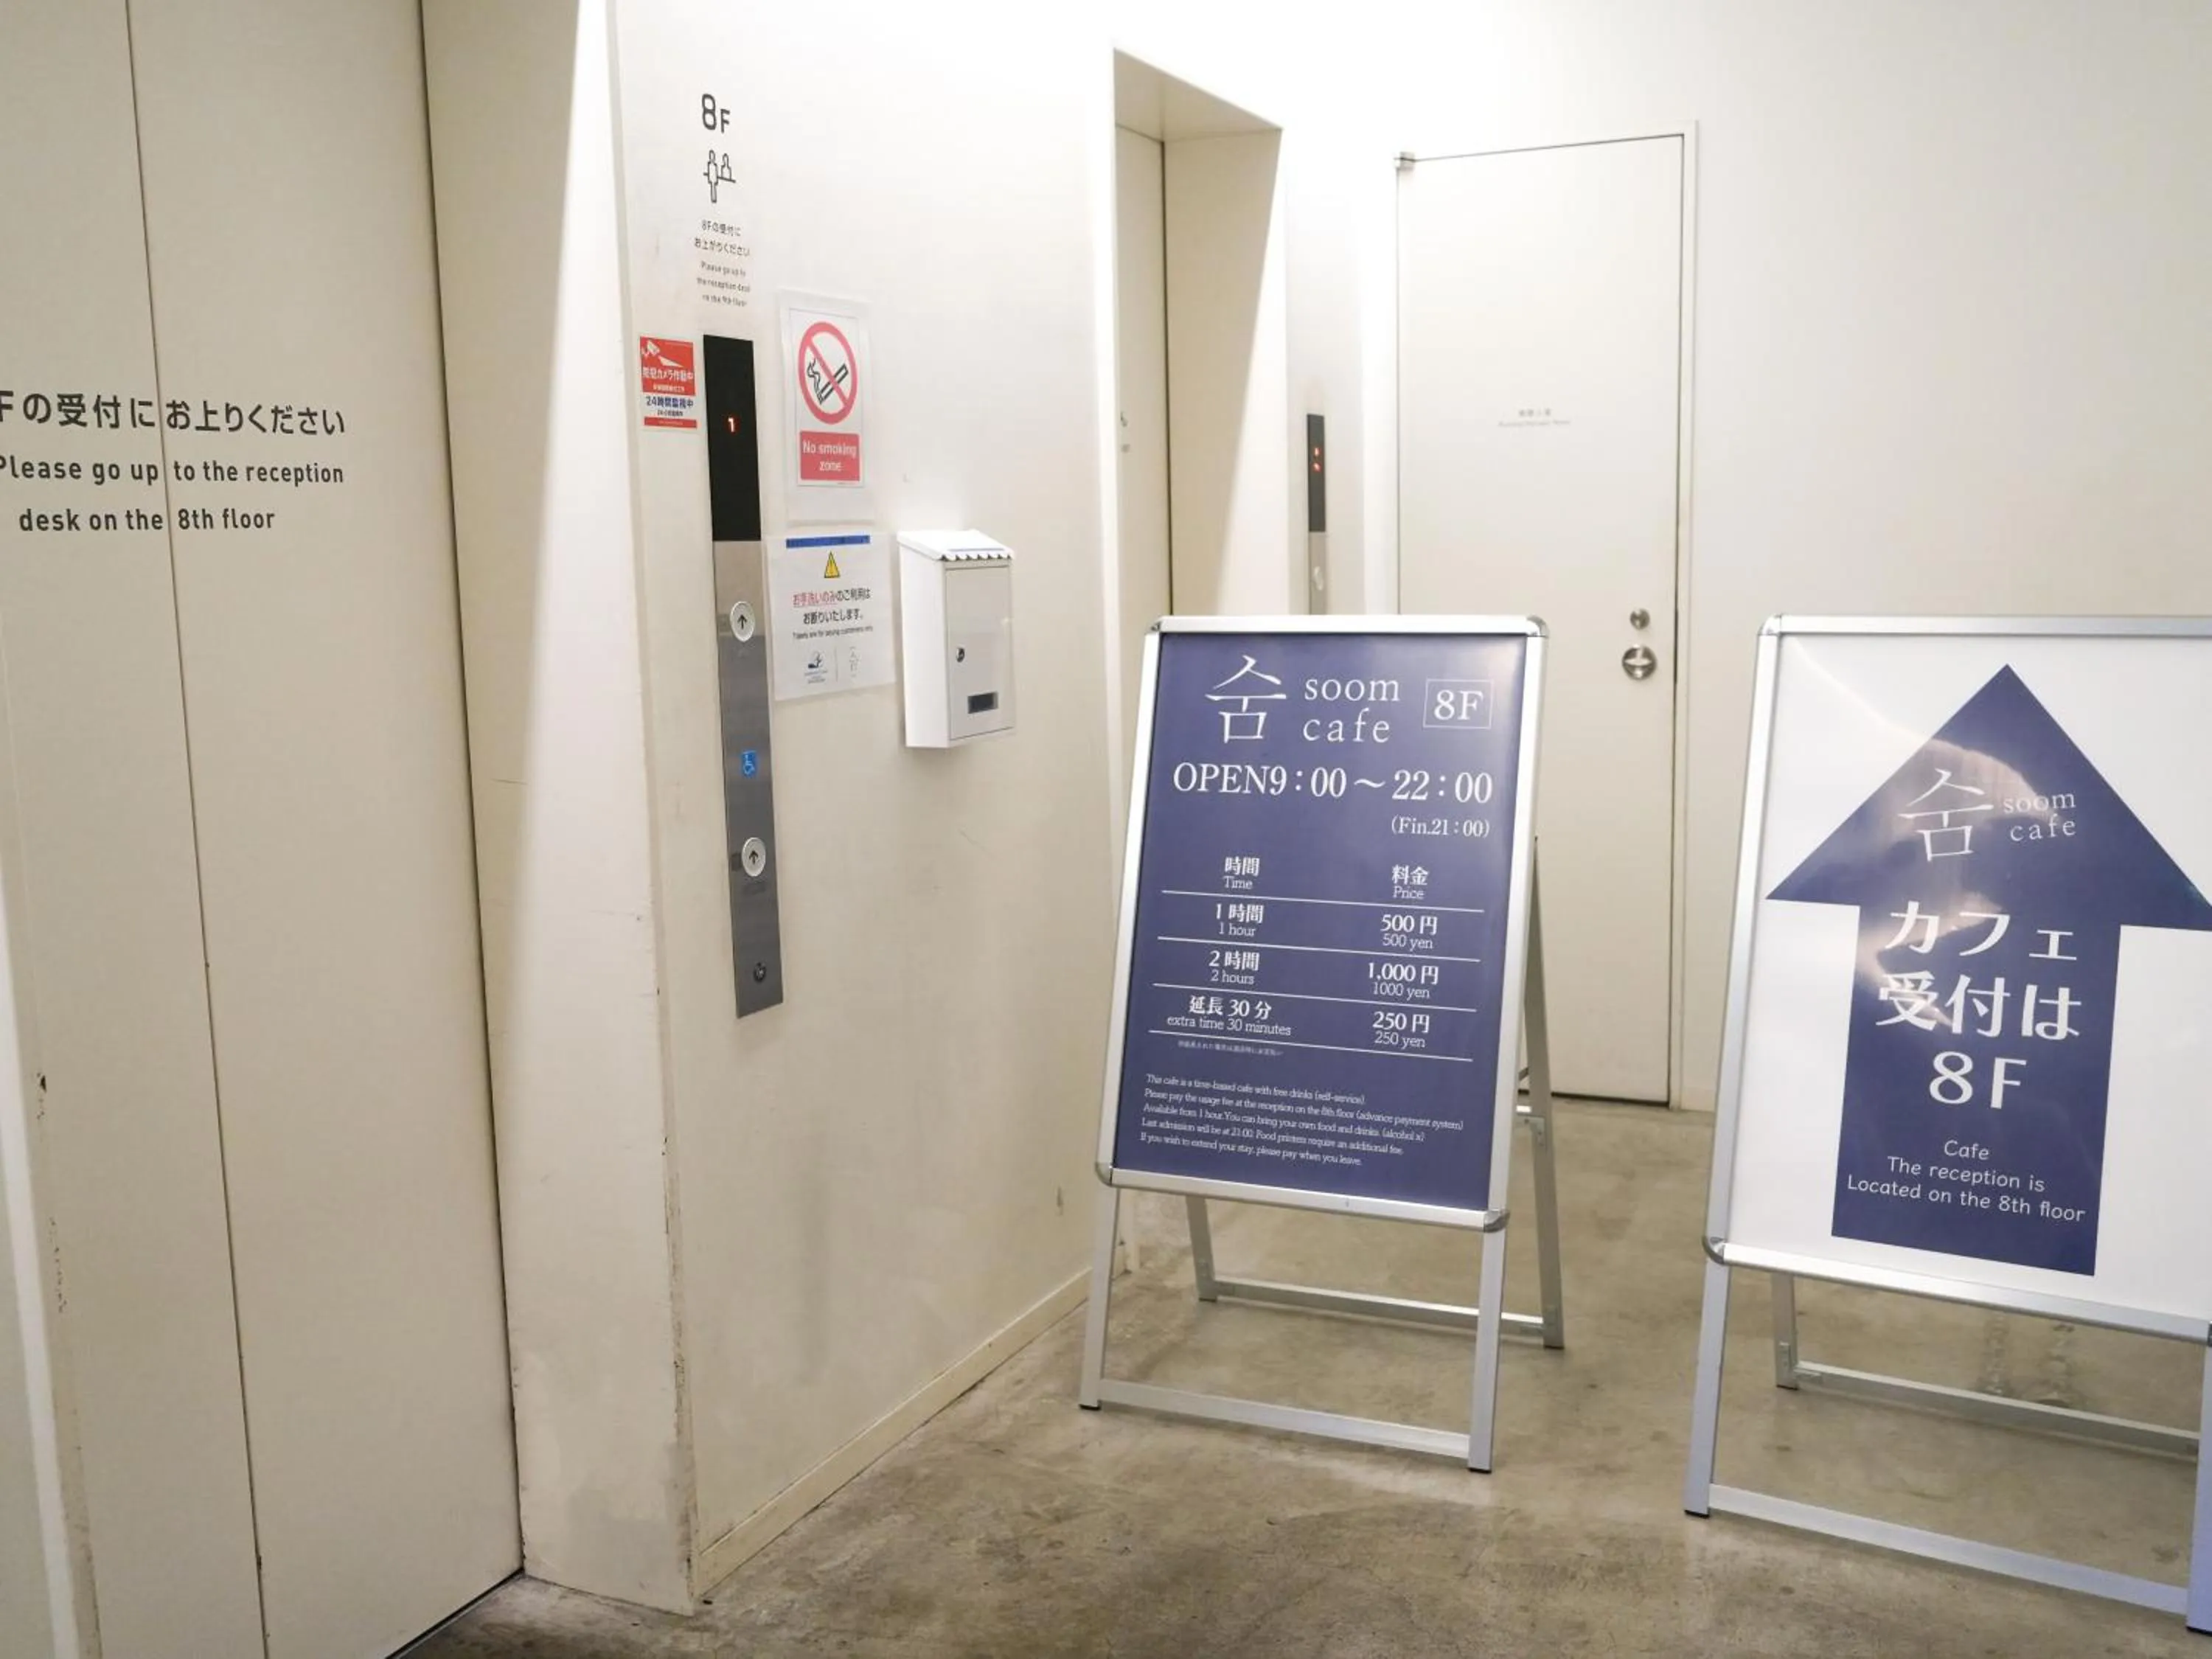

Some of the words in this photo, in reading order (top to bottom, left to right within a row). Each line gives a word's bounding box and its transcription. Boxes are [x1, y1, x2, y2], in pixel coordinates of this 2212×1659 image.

[701, 93, 730, 133] 8F
[802, 439, 816, 454] No
[818, 442, 857, 459] smoking
[92, 462, 120, 485] go
[131, 463, 159, 486] up
[173, 461, 195, 481] to
[203, 460, 238, 481] the
[246, 462, 344, 487] reception
[19, 508, 80, 532] desk
[89, 513, 117, 530] on
[125, 509, 164, 530] the
[178, 508, 214, 530] 8th
[222, 508, 275, 529] floor
[1304, 677, 1400, 702] soom
[1434, 689, 1485, 722] 8F
[1303, 707, 1391, 743] cafe
[2003, 791, 2076, 815] soom
[2010, 813, 2076, 842] cafe
[1224, 856, 1260, 877] 時間
[1391, 864, 1429, 886] 料金
[1222, 876, 1253, 890] Time
[1393, 886, 1425, 900] Price
[1219, 922, 1224, 934] 1
[1228, 922, 1256, 937] hour
[1885, 900, 2077, 961] カフェ
[1382, 933, 1407, 947] 500
[1410, 937, 1433, 952] yen
[1211, 970, 1219, 982] 2
[1222, 970, 1255, 985] hours
[1373, 982, 1403, 996] 1000
[1407, 987, 1430, 1001] yen
[1876, 970, 2082, 1040] 受付は
[1167, 1015, 1196, 1028] extra
[1199, 1016, 1224, 1030] time
[1227, 1018, 1242, 1032] 30
[1245, 1020, 1292, 1036] minutes
[1374, 1032, 1399, 1046] 250
[1402, 1036, 1426, 1050] yen
[1194, 1079, 1236, 1091] time-based
[1255, 1086, 1271, 1096] with
[1273, 1087, 1287, 1096] free
[1290, 1088, 1312, 1099] drinks
[1929, 1051, 2027, 1110] 8F
[1144, 1088, 1168, 1099] Please
[1169, 1093, 1183, 1103] pay
[1186, 1093, 1197, 1102] the
[1198, 1097, 1221, 1106] usage
[1244, 1099, 1256, 1108] the
[1257, 1103, 1294, 1113] reception
[1307, 1105, 1321, 1115] the
[1336, 1108, 1354, 1118] floor
[1356, 1110, 1394, 1122] (advance
[1394, 1116, 1431, 1127] payment
[1180, 1108, 1197, 1117] from
[1256, 1116, 1278, 1128] bring
[1279, 1120, 1297, 1129] your
[1298, 1122, 1316, 1130] own
[1318, 1121, 1336, 1132] food
[1338, 1125, 1353, 1134] and
[1141, 1117, 1158, 1127] Last
[1197, 1124, 1210, 1133] will
[1256, 1130, 1276, 1141] Food
[1308, 1138, 1335, 1148] require
[1349, 1141, 1388, 1153] additional
[1147, 1135, 1162, 1144] you
[1191, 1140, 1217, 1150] extend
[1218, 1144, 1236, 1152] your
[1256, 1146, 1281, 1156] please
[1282, 1151, 1298, 1161] pay
[1298, 1150, 1321, 1161] when
[1322, 1155, 1338, 1164] you
[1944, 1139, 1989, 1161] Cafe
[1888, 1155, 1921, 1175] The
[1929, 1165, 2020, 1189] reception
[2029, 1175, 2045, 1192] is
[1848, 1175, 1921, 1199] Located
[1928, 1189, 1951, 1203] on
[1960, 1191, 1991, 1209] the
[1998, 1195, 2030, 1214] 8th
[2040, 1200, 2086, 1222] floor
